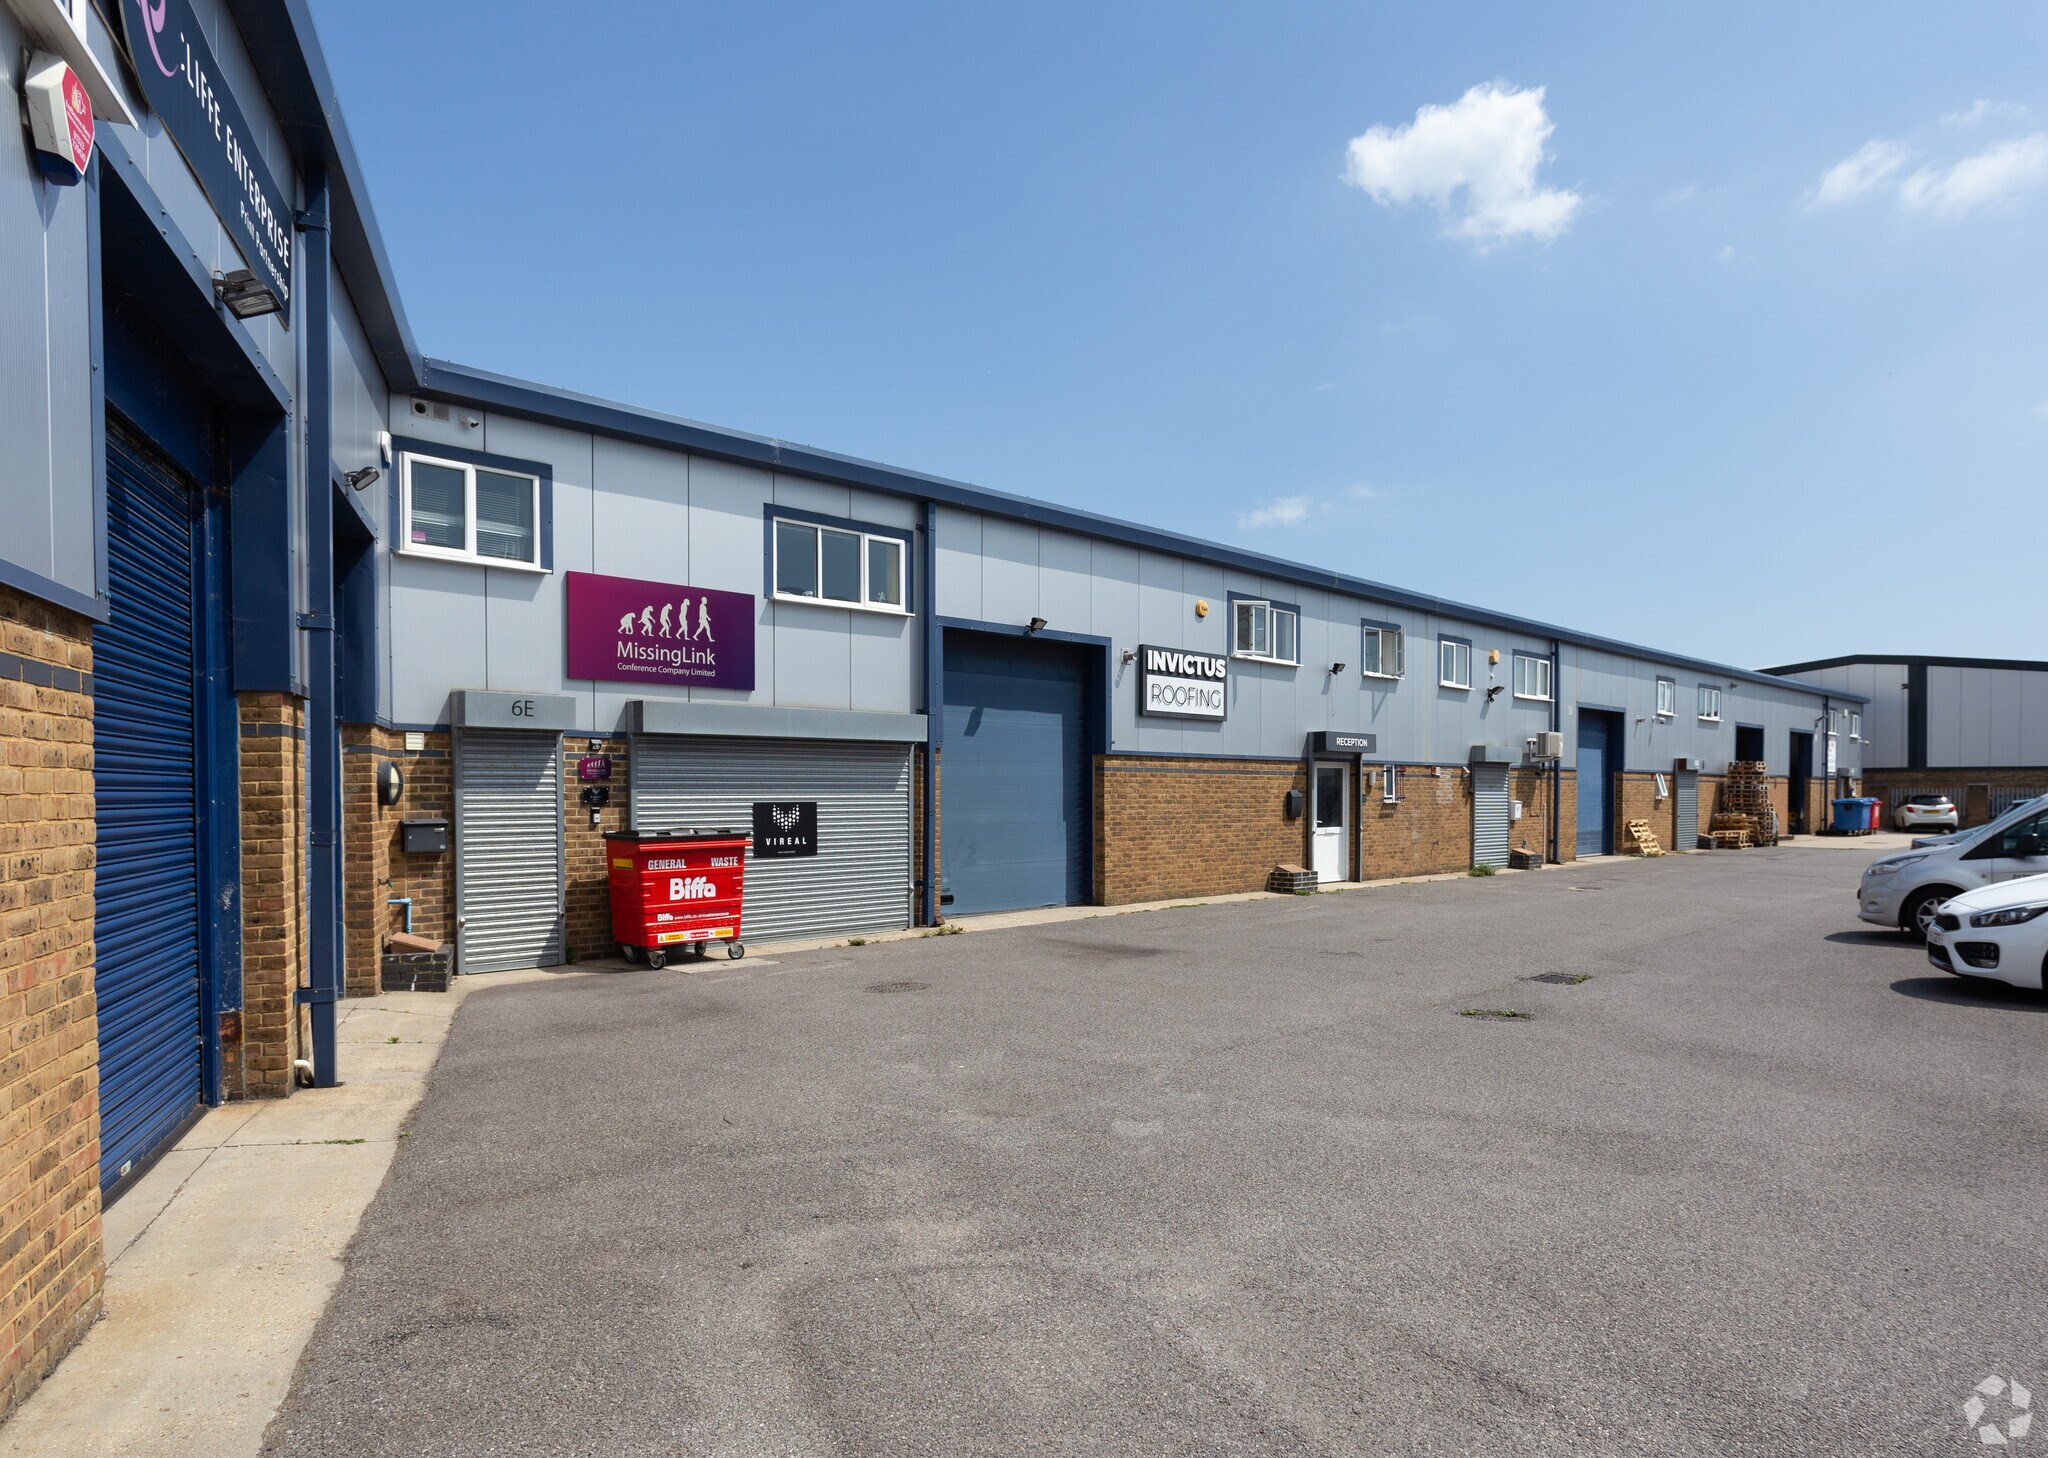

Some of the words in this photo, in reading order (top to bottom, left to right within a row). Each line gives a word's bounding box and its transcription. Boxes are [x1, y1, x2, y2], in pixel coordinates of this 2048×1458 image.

[226, 124, 290, 269] ENTERPRISE
[240, 200, 255, 241] Print
[256, 230, 289, 302] Partnership
[617, 640, 716, 666] MissingLink
[617, 662, 658, 673] Conference
[658, 665, 690, 677] Company
[691, 668, 716, 677] Limited
[1147, 649, 1226, 679] INVICTUS
[1151, 683, 1221, 709] ROOFING
[511, 700, 534, 717] 6E
[1336, 737, 1368, 748] RECEPTION
[765, 836, 807, 846] VIREAL
[648, 859, 686, 870] GENERAL
[711, 857, 738, 867] WASTE
[670, 876, 716, 900] Biffa
[657, 913, 673, 921] Biffa
